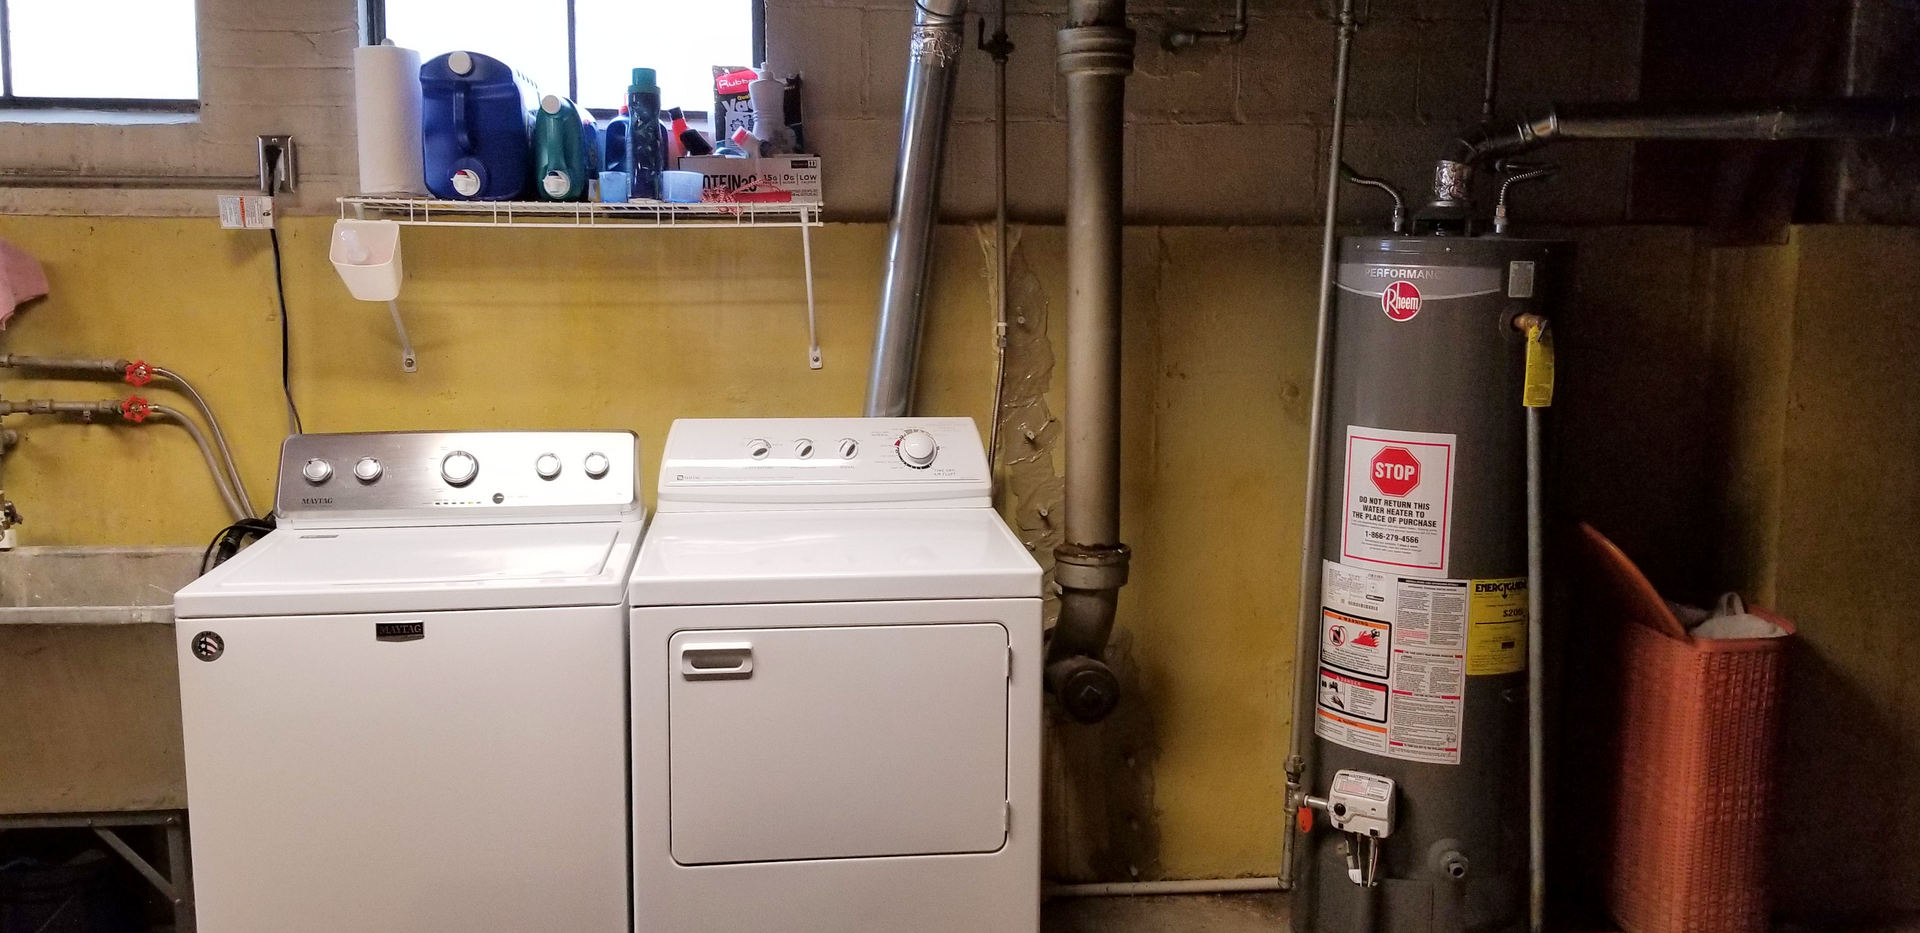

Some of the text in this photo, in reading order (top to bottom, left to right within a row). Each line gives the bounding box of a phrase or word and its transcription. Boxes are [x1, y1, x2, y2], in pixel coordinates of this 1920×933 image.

[1365, 268, 1441, 280] PERFORMANC
[1386, 282, 1419, 315] Rheem
[1375, 461, 1415, 481] STOP
[1370, 497, 1382, 506] NOT
[1384, 499, 1411, 509] RETURN
[1414, 502, 1431, 511] THIS
[1363, 505, 1425, 519] WATER HEATER TO
[1352, 511, 1437, 528] THE PLACE OF PURCHASE
[1365, 530, 1419, 544] 1-866-279-4566
[380, 624, 422, 635] MAYTAG
